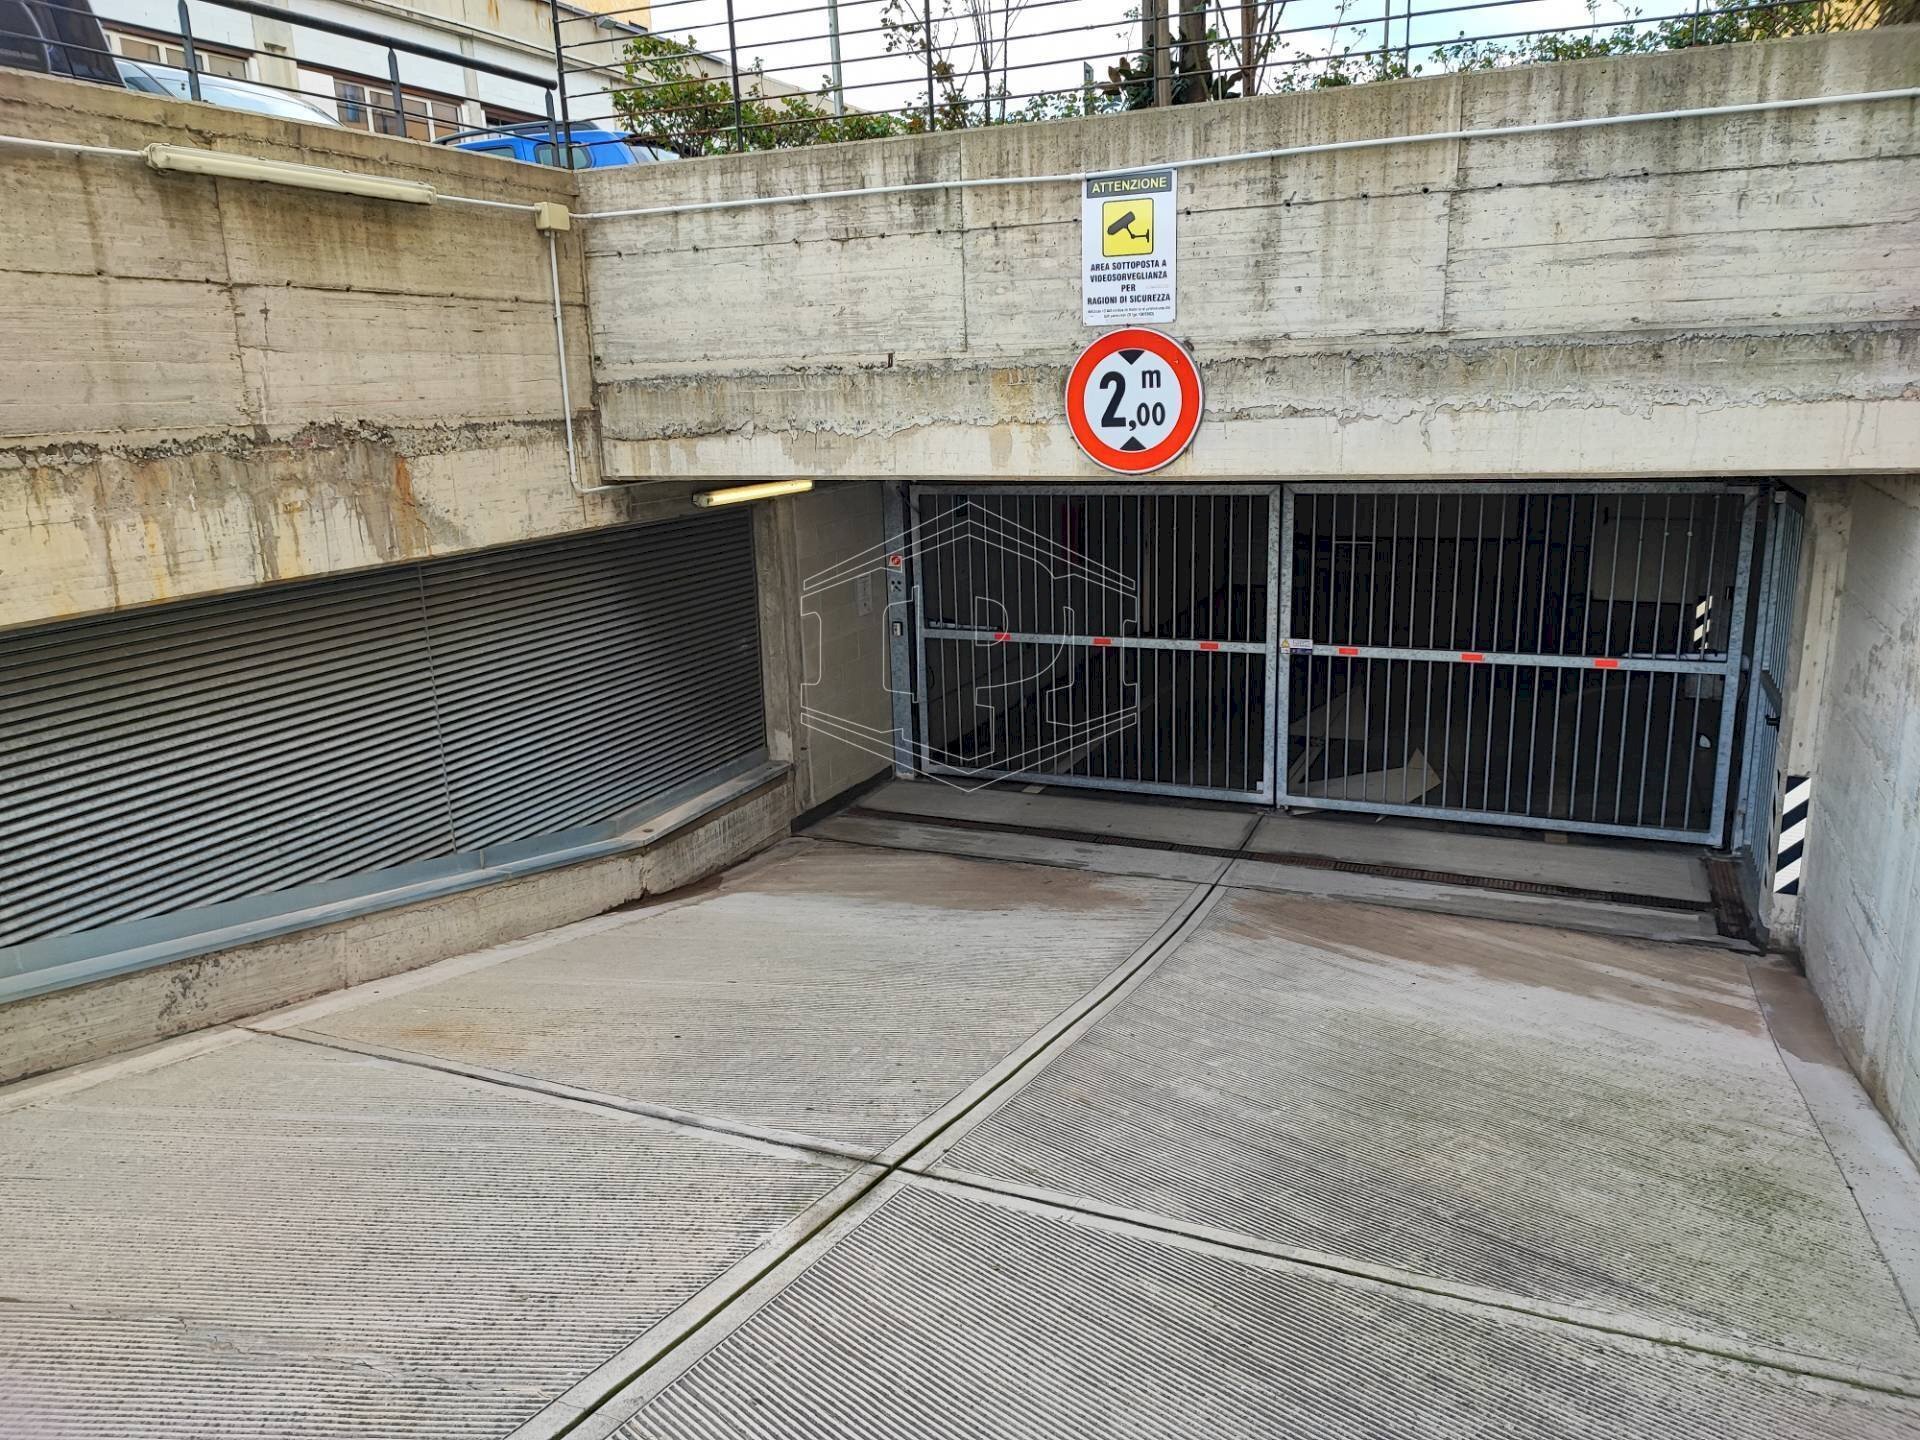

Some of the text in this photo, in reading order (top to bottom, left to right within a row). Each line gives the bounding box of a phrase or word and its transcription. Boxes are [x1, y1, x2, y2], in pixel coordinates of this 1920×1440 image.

[1092, 176, 1168, 194] ATTENZIONE
[1090, 259, 1167, 271] AREA SOTTOPOSTA A
[1090, 271, 1168, 283] VIDEOSORVEGLIANZA
[1121, 284, 1136, 292] PER
[1087, 293, 1171, 305] RAGIONI DI SICUREZZA
[1141, 369, 1162, 389] m
